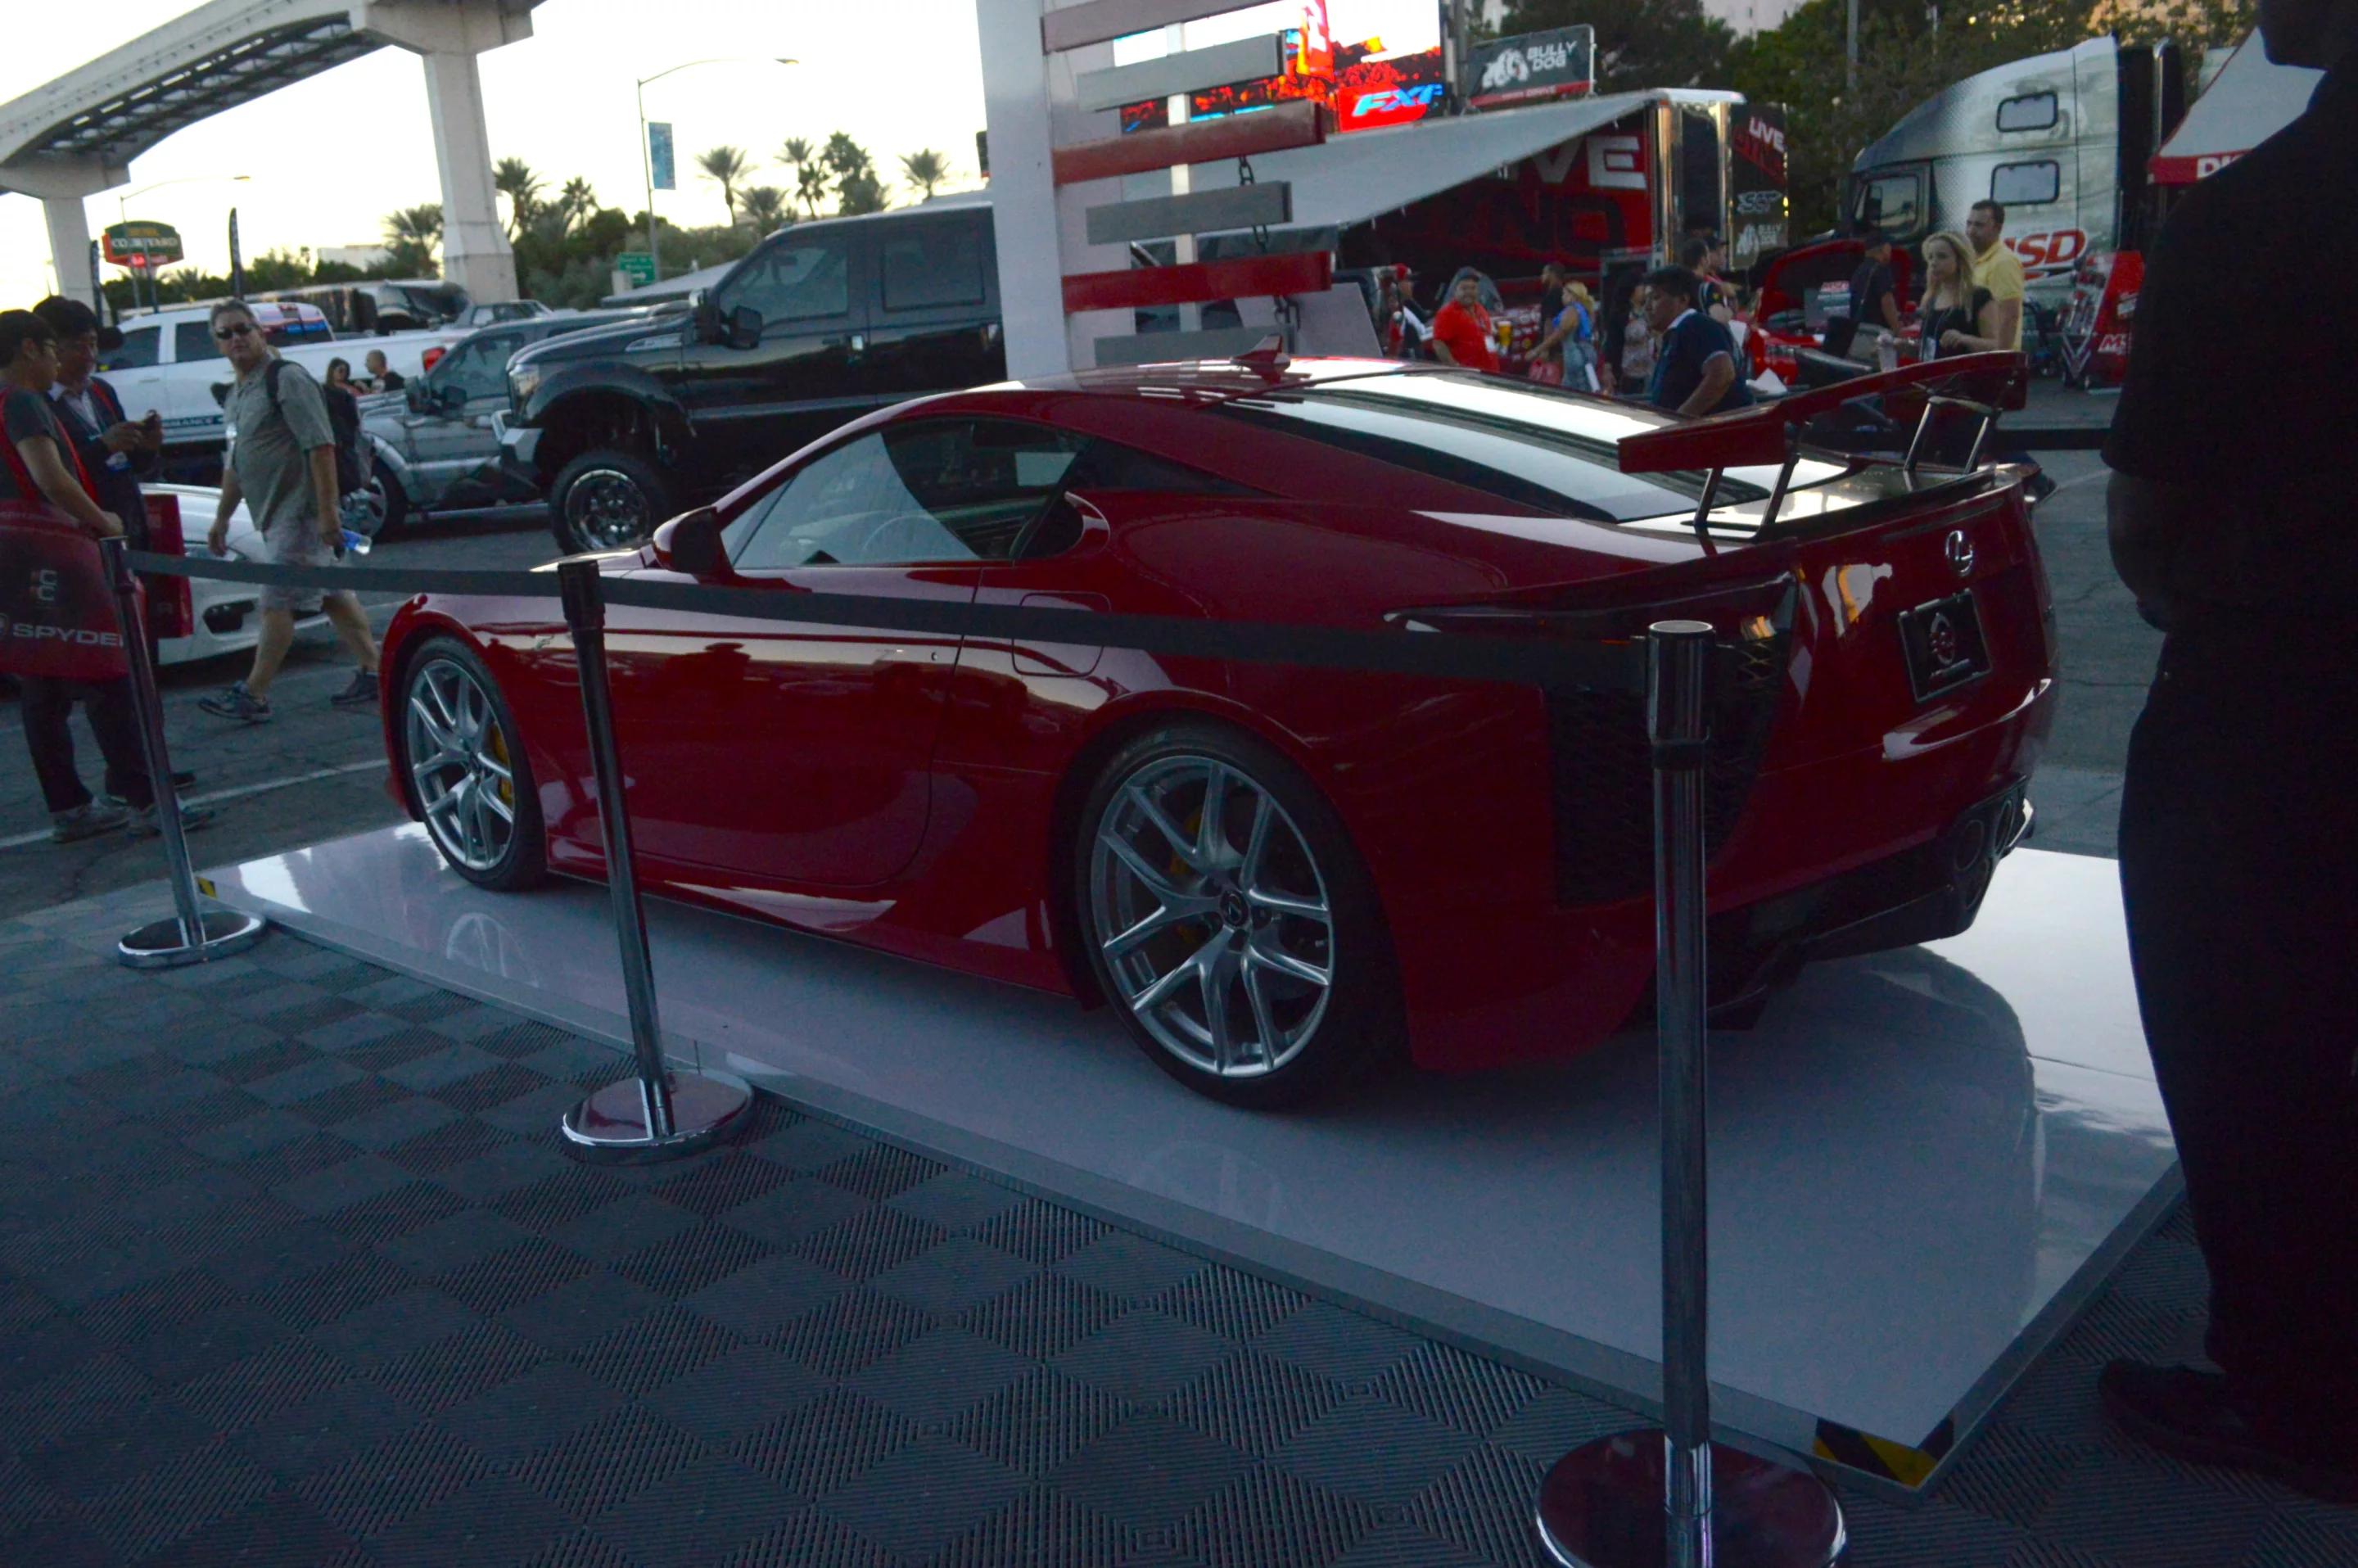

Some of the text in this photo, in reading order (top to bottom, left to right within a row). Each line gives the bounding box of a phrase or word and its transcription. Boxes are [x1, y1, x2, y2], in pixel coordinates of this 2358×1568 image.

[1527, 41, 1577, 61] BULLY
[1531, 55, 1567, 72] DOG
[1749, 116, 1786, 153] LIVE
[2004, 229, 2086, 269] SD
